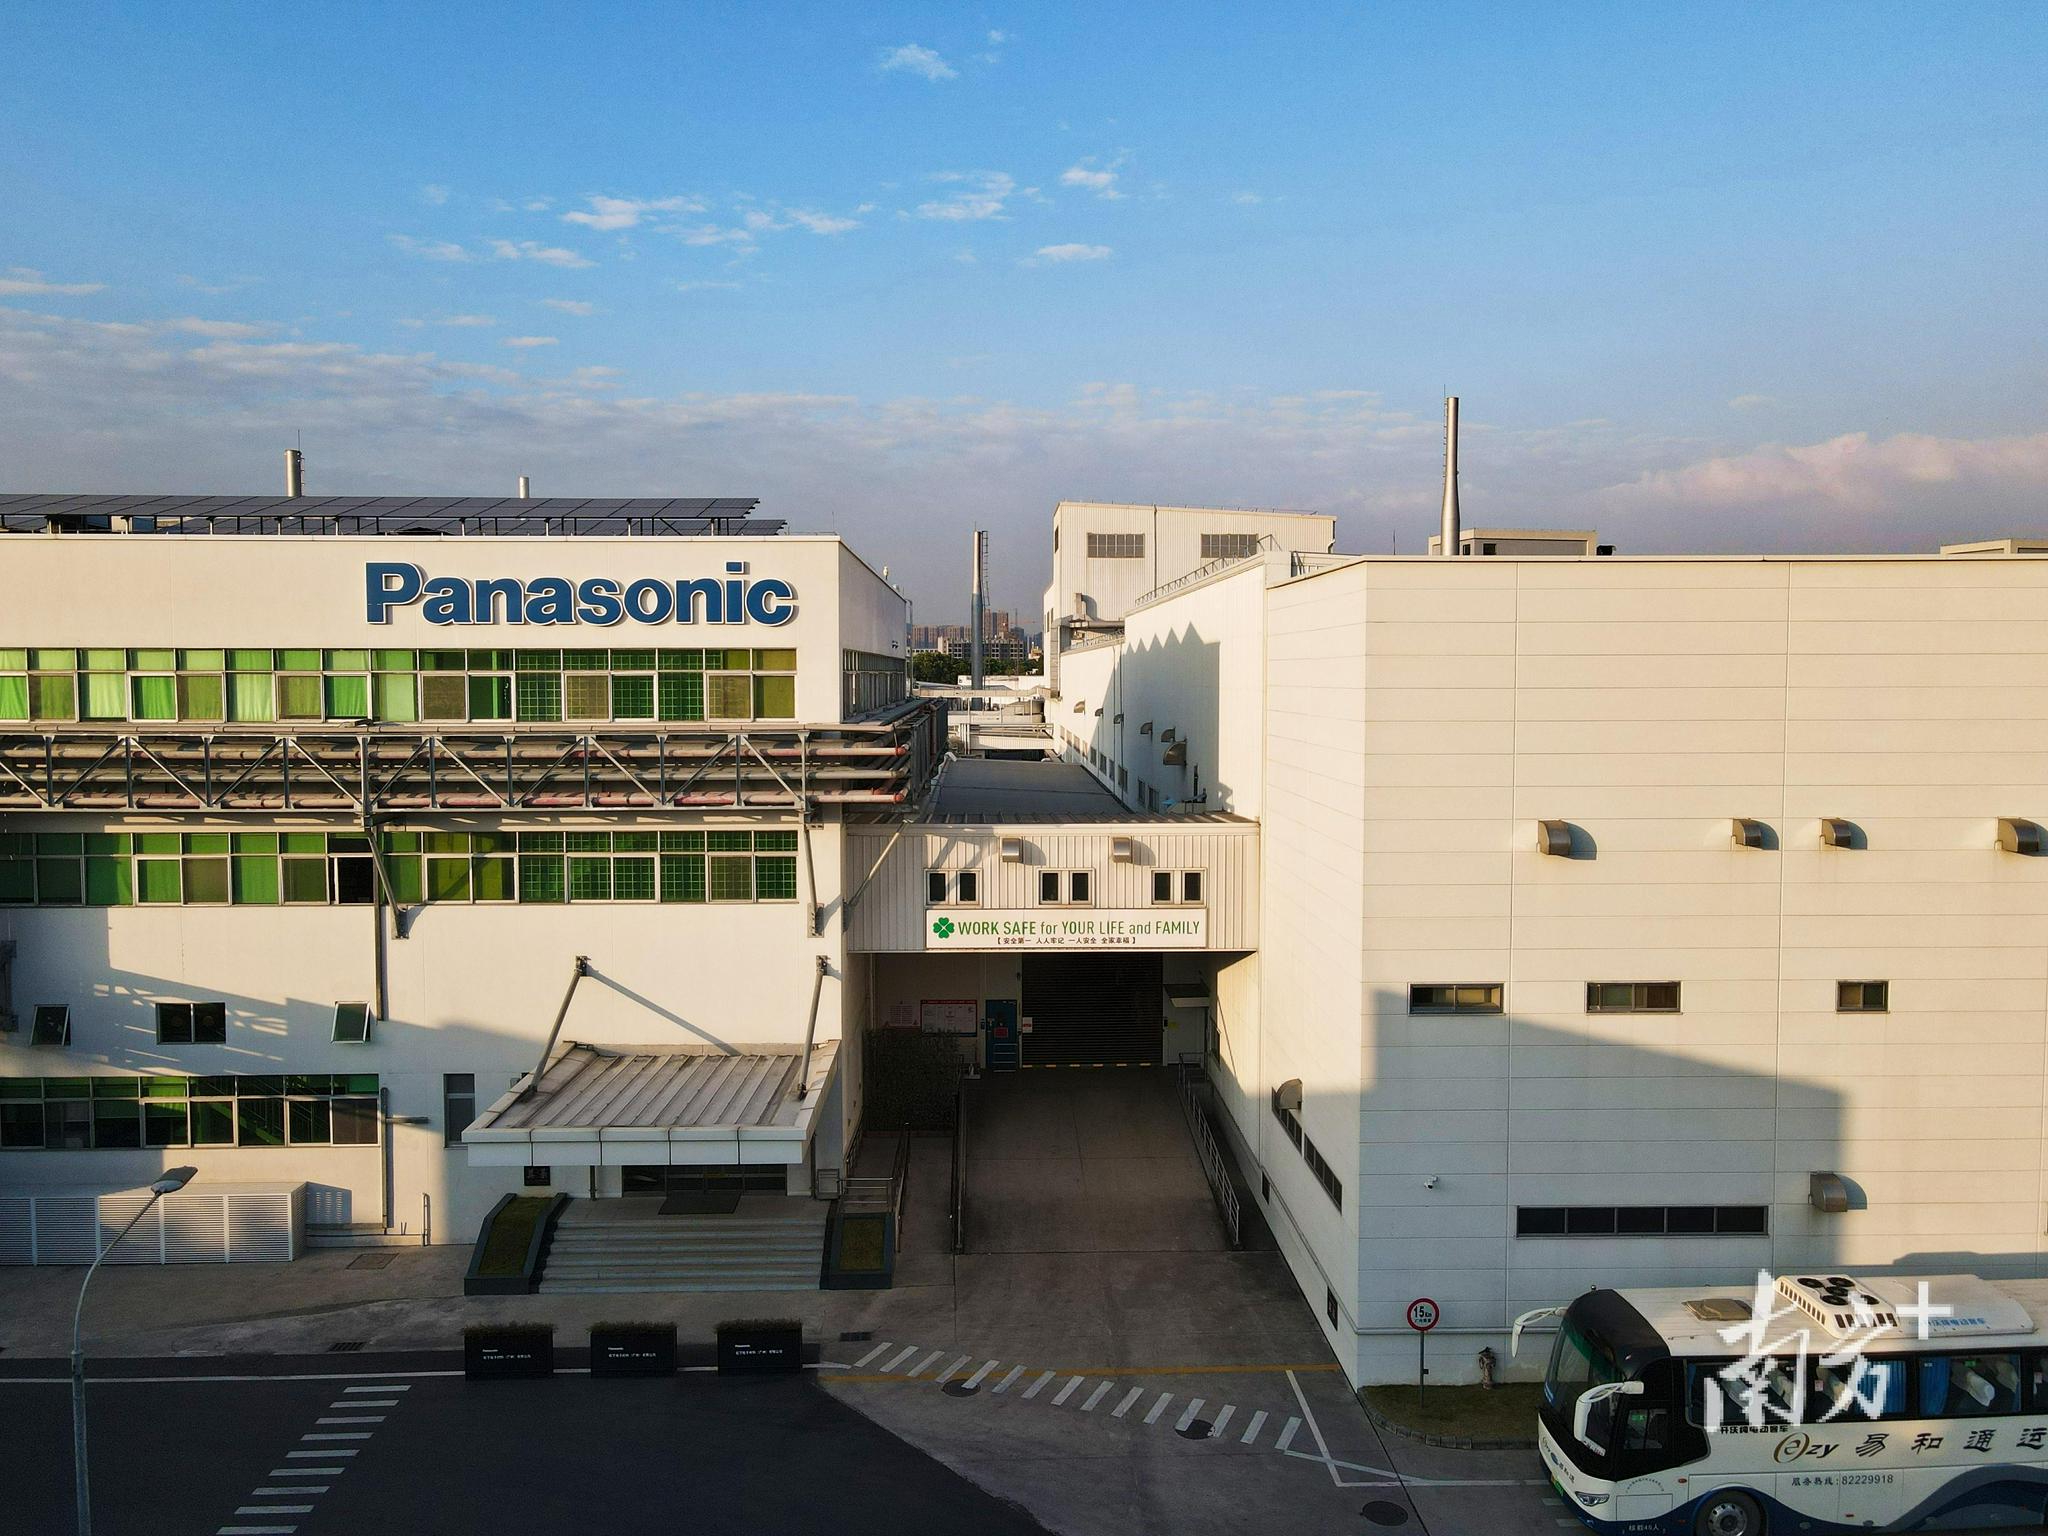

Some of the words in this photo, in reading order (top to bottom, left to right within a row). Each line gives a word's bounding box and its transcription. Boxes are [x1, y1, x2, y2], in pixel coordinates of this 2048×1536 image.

[365, 561, 797, 627] Panasonic
[958, 920, 999, 935] WORK
[1003, 920, 1036, 935] SAFE
[1040, 920, 1057, 935] for
[1062, 920, 1094, 935] YOUR
[1099, 920, 1124, 935] LIFE
[1129, 920, 1151, 935] and
[1155, 920, 1200, 935] FAMILY
